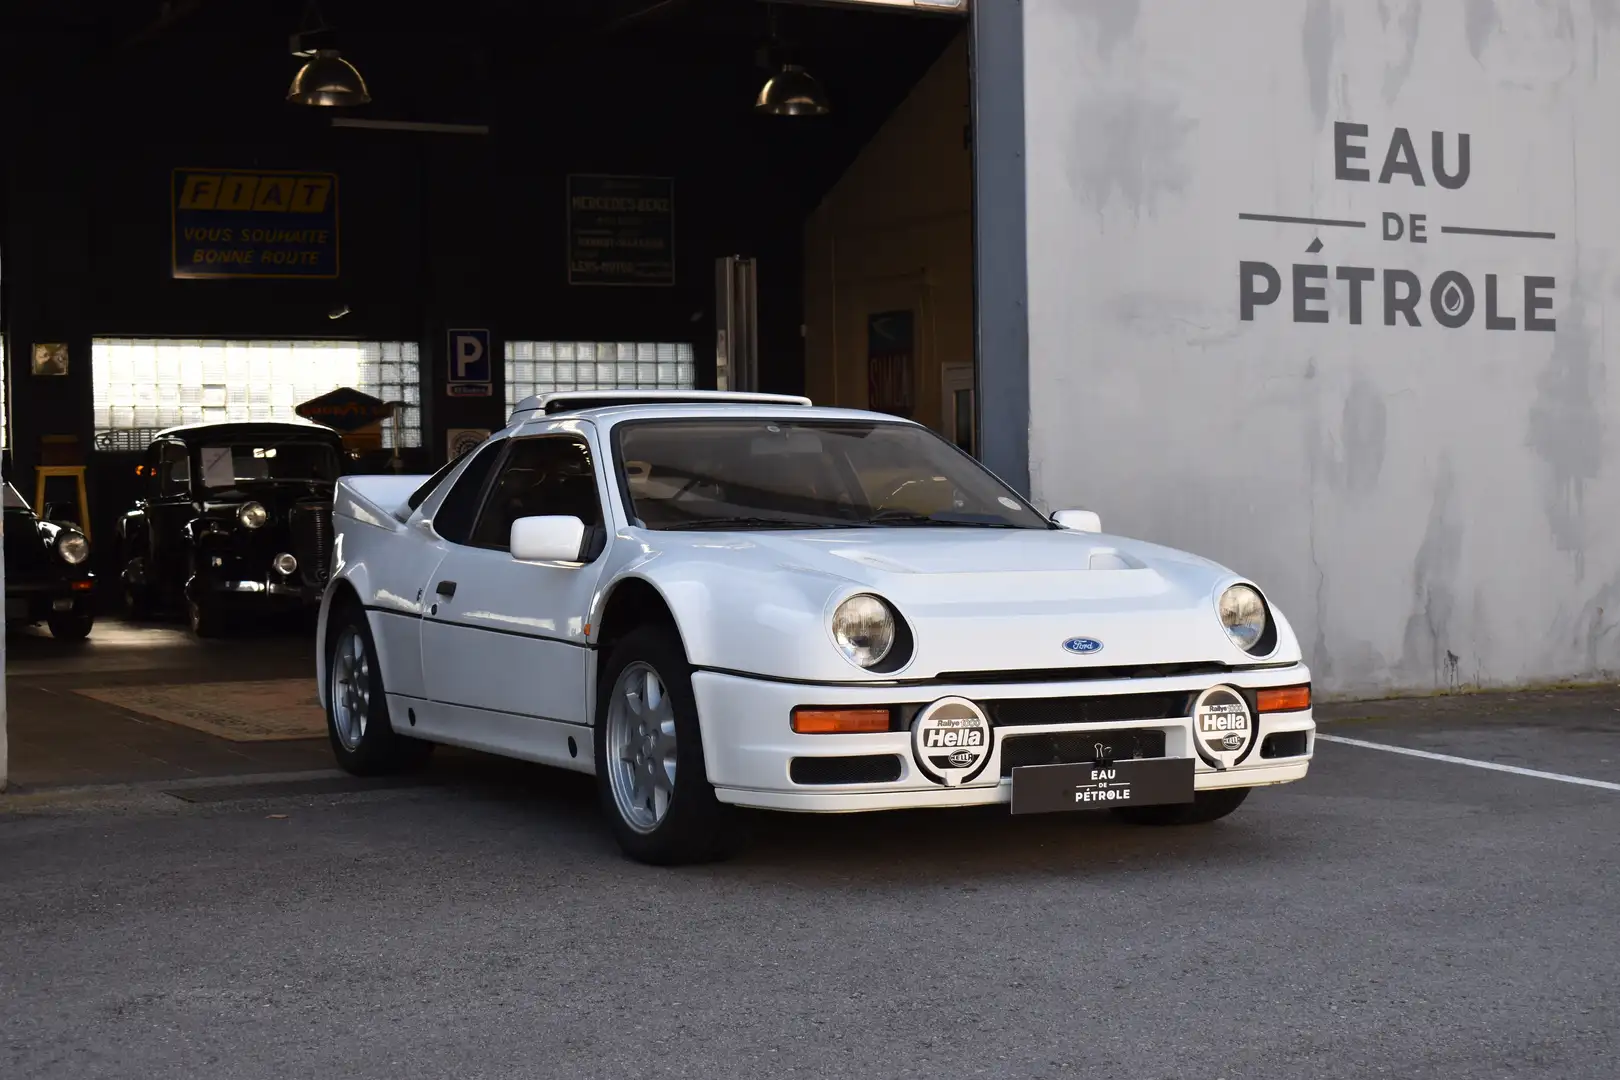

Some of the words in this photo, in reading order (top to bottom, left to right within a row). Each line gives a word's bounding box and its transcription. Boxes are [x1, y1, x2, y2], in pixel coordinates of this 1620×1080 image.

[1334, 121, 1470, 190] EAU
[189, 181, 326, 207] FIAT
[184, 227, 234, 242] VOUS
[240, 227, 329, 244] SOUHAITE
[1382, 211, 1427, 243] DE
[192, 247, 255, 264] BONNE
[261, 249, 320, 266] ROUTE
[1239, 237, 1556, 332] PÉTROLE
[457, 336, 484, 377] P
[1073, 639, 1093, 650] Ford
[1203, 713, 1245, 731] Hella
[927, 729, 981, 747] Hella
[1091, 769, 1116, 780] EAU
[1075, 788, 1130, 802] PÉTROLE
